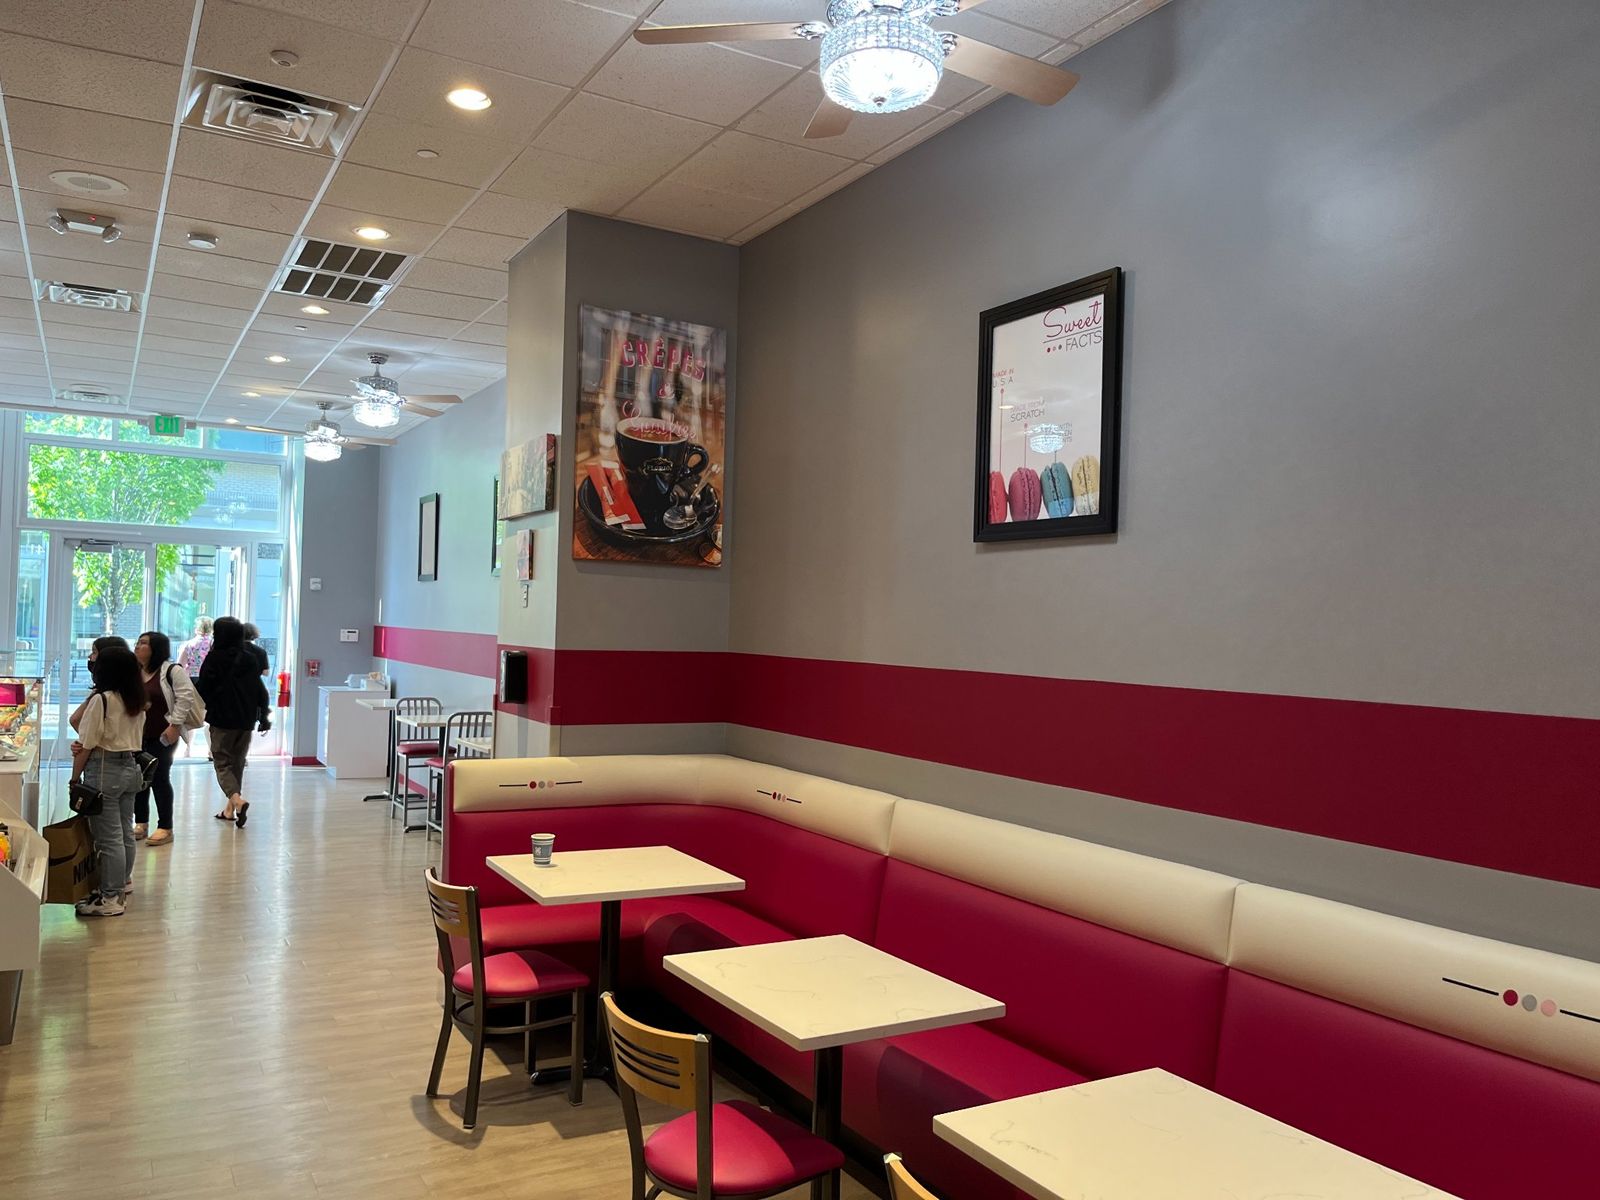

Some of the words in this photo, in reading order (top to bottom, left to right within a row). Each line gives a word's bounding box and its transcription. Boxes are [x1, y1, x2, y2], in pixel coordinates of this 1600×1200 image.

[1043, 300, 1102, 338] Sweet
[1065, 330, 1103, 352] FACTS
[154, 415, 179, 433] EXIT
[1010, 408, 1045, 422] SCRATCH
